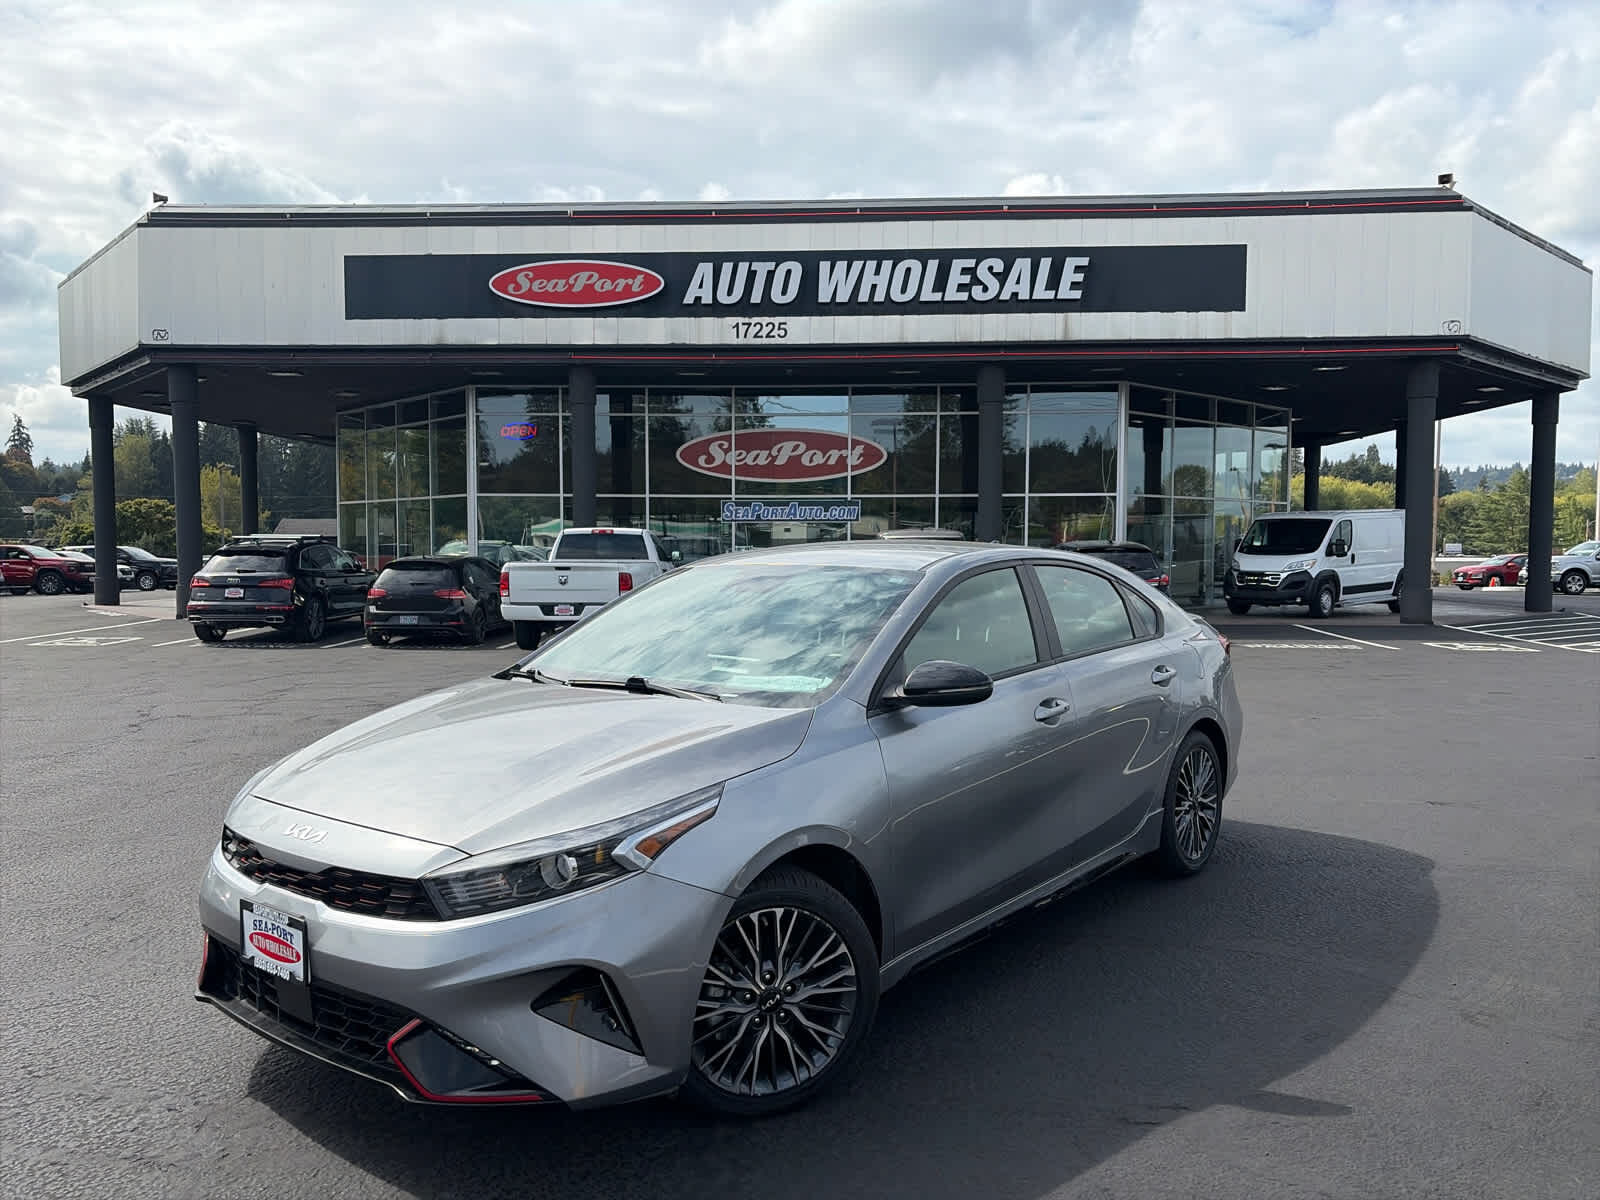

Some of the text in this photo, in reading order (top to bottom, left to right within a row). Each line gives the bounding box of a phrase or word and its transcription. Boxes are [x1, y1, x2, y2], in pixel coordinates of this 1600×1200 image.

[507, 271, 645, 295] SeaPort
[682, 257, 1090, 305] AUTO WHOLESALE
[732, 321, 788, 339] 17225
[500, 425, 537, 437] OPEN
[698, 440, 865, 468] SeaPort
[282, 823, 329, 843] KIA
[252, 919, 295, 945] SEA-PORT
